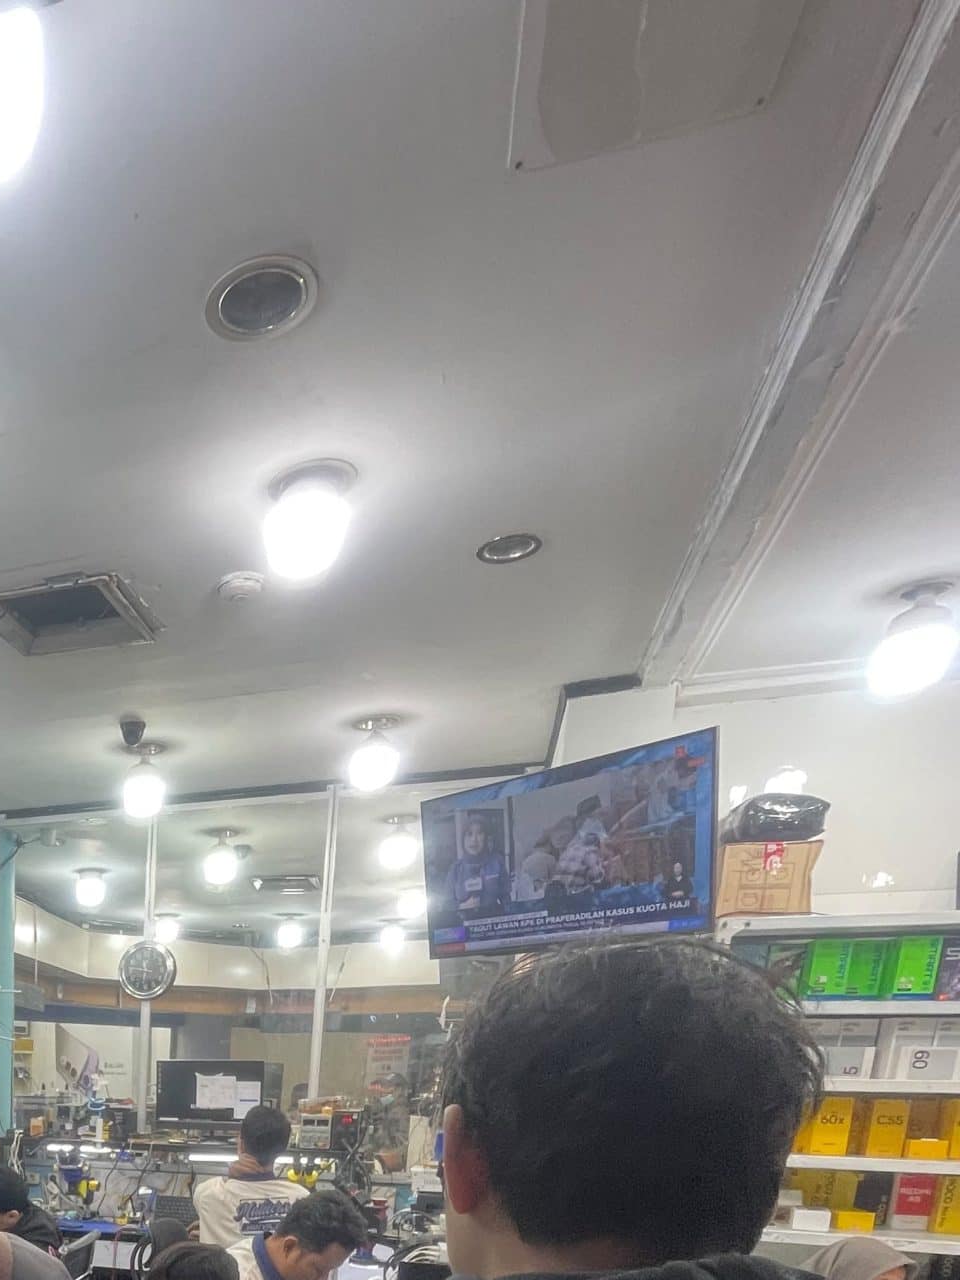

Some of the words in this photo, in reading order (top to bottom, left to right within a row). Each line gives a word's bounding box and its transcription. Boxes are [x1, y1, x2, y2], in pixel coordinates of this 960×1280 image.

[606, 906, 635, 917] KASUS
[636, 902, 667, 914] KUOTA
[669, 899, 690, 910] HAJI
